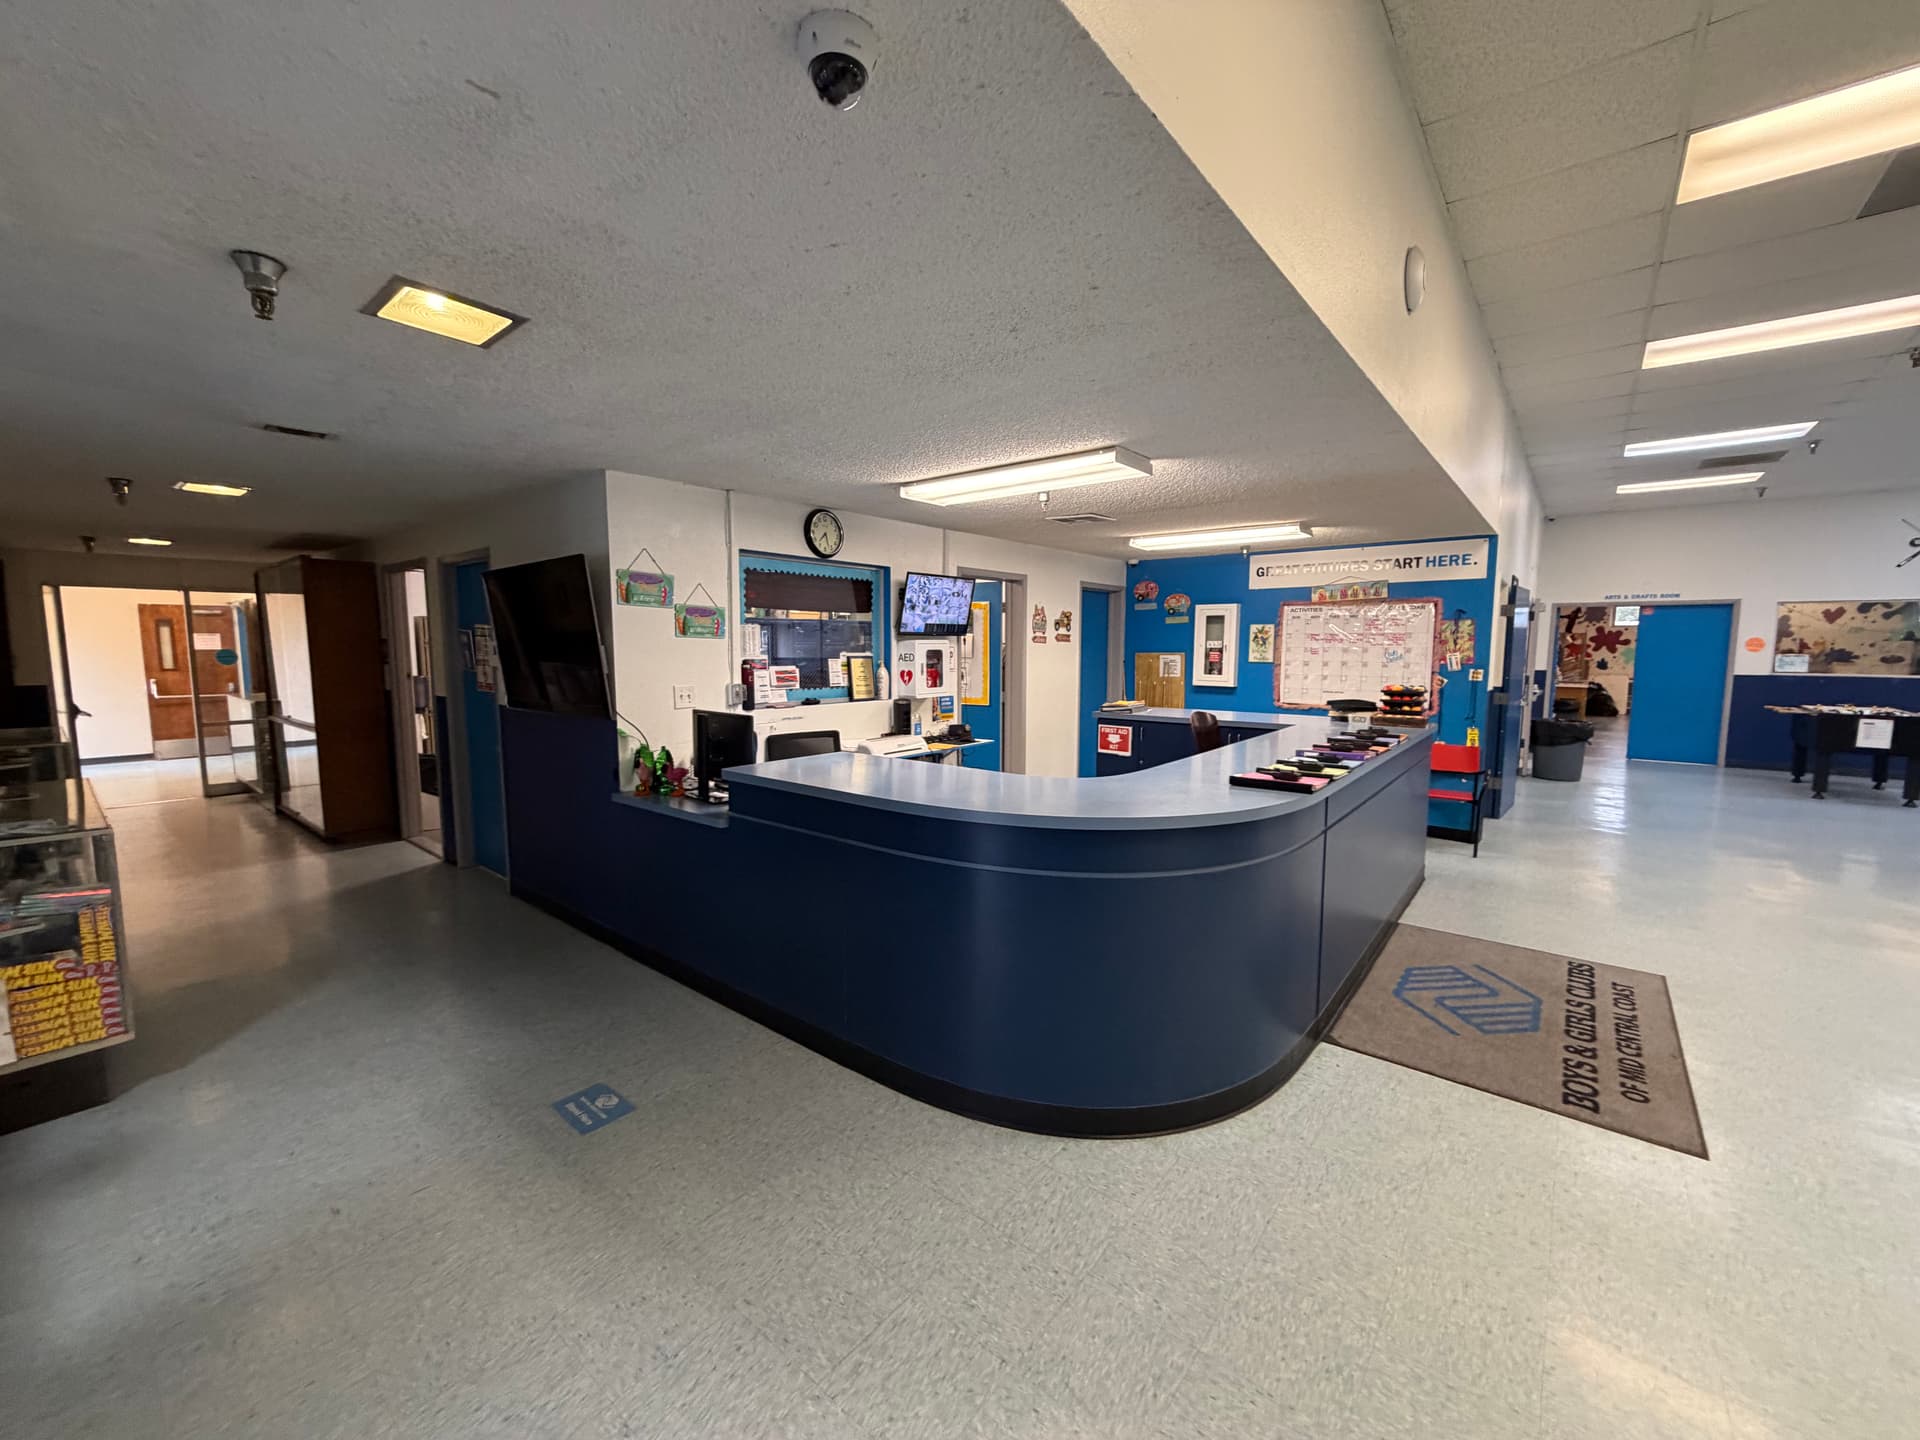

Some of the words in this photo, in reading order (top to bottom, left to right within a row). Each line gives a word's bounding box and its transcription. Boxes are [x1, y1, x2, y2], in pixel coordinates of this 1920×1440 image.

[1256, 564, 1300, 577] GREAT
[1303, 560, 1369, 573] FUTURES
[1373, 556, 1423, 571] START
[1425, 553, 1478, 568] HERE.
[898, 652, 915, 662] AED
[1565, 961, 1595, 1000] CLUBS
[1611, 981, 1637, 1012] COAST
[1564, 999, 1597, 1043] GIRLS
[1613, 1012, 1643, 1058] CENTRAL
[1563, 1044, 1598, 1060] &
[1562, 1057, 1600, 1114] BOYS
[1617, 1057, 1649, 1085] MID
[1618, 1081, 1652, 1104] OF
